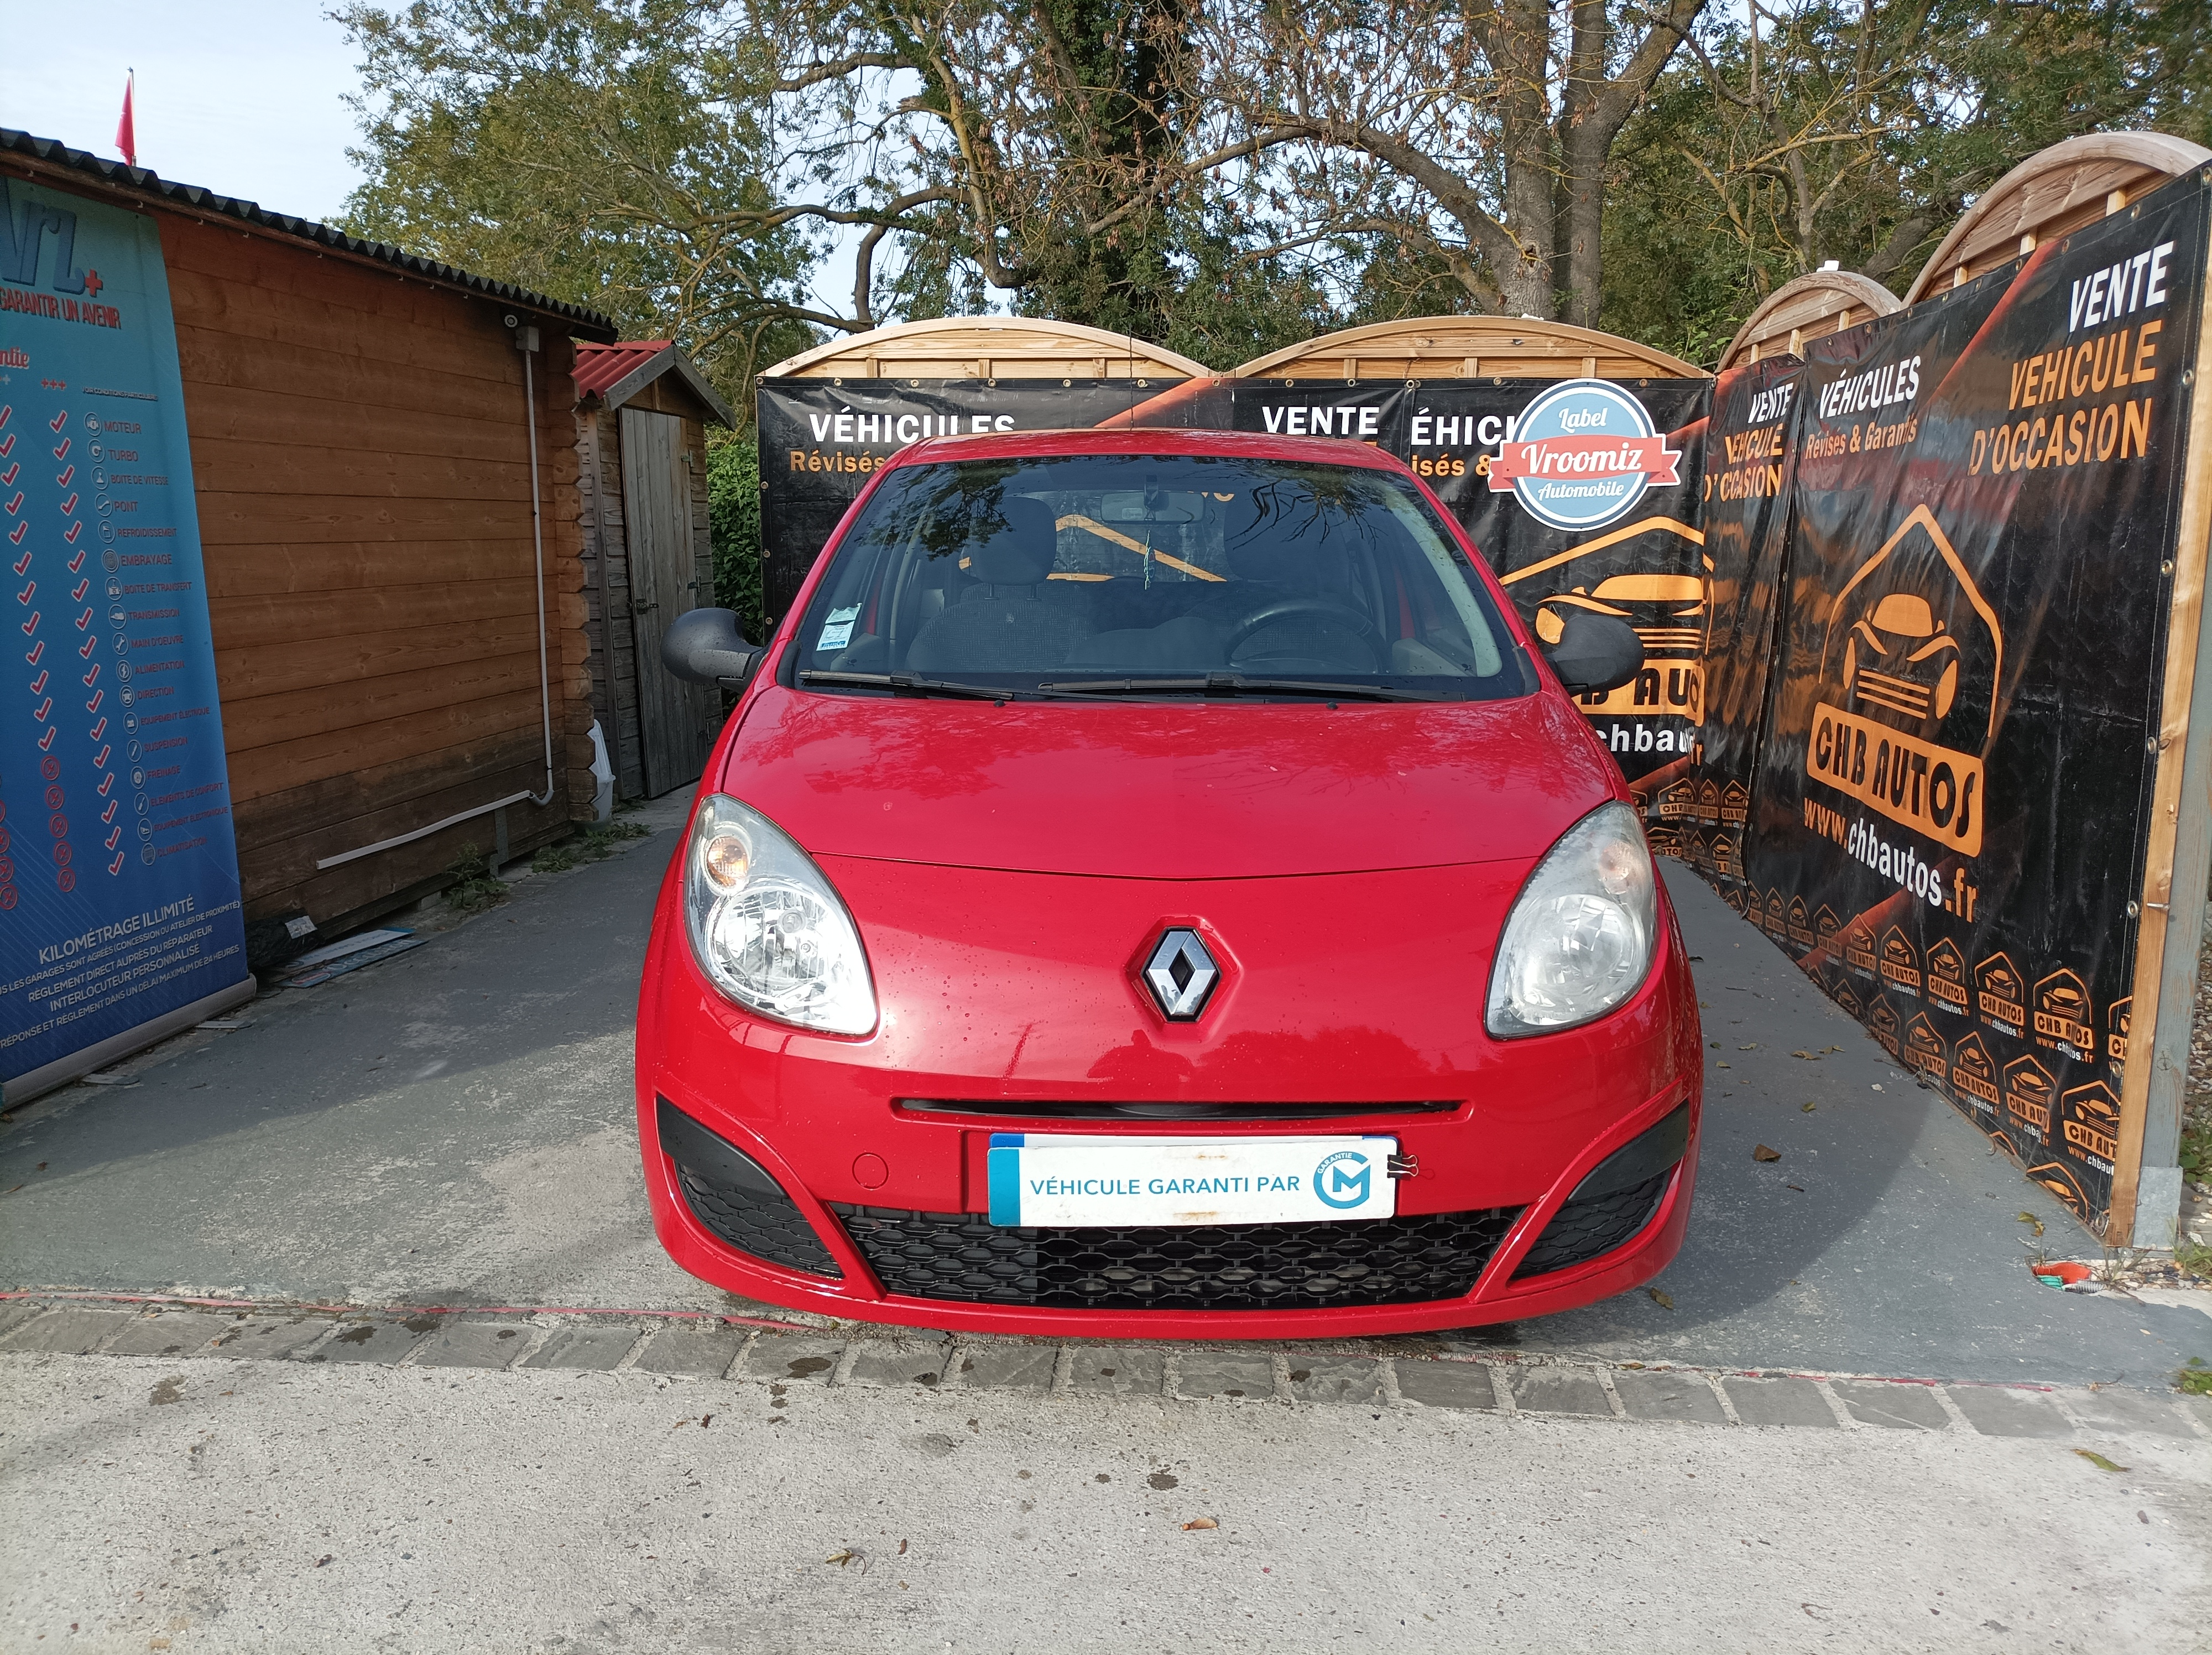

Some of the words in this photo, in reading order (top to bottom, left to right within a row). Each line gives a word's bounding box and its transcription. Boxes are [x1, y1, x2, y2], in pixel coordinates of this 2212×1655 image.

[2069, 241, 2174, 332] VENTE
[61, 298, 79, 322] UN
[82, 301, 121, 329] AVENIR
[2008, 319, 2163, 412] VEHICULE
[1819, 356, 1921, 419] VÉHICULES
[1748, 383, 1793, 424] VENTE
[104, 420, 141, 434] MOTEUR
[1262, 407, 1379, 435] VENTE
[1411, 408, 1516, 445] ÉHIC
[1558, 407, 1608, 433] Label
[1806, 426, 1846, 459] Révisés
[1850, 425, 1861, 452] &
[1969, 398, 2152, 476] D'OCCASION
[108, 450, 138, 461] TURBO
[790, 450, 885, 473] Révisés
[1521, 442, 1643, 473] Vroomiz
[111, 475, 131, 484] BOITE
[133, 476, 142, 485] DE
[144, 476, 168, 485] VITESSE
[1537, 482, 1624, 501] Automobile
[114, 501, 138, 512] PONT
[118, 528, 176, 538] REFROIDISSEMENT
[121, 554, 172, 566] EMBRAYAGE
[124, 585, 145, 594] BOITE
[146, 584, 155, 593] DE
[128, 608, 180, 621] TRANSMISSION
[131, 638, 150, 648] MAIN
[135, 660, 184, 674] ALIMENTATION
[137, 686, 174, 699] DIRECTION
[140, 712, 178, 725] EQUIPEMENT
[144, 737, 187, 752] SUSPENSION
[147, 765, 180, 779] FREINAGE
[1815, 716, 1867, 787] CHB
[1877, 738, 1976, 839] AUTOS
[186, 789, 194, 798] DE
[157, 836, 207, 857] CLIMATISATION
[1803, 797, 1978, 923] www.chbautos.fr
[39, 915, 140, 965] KILOMÉTRAGE
[143, 893, 195, 928] ILLIMITÉ
[9, 979, 24, 991] LES
[25, 965, 65, 985] GARAGES
[65, 957, 85, 971] SONT
[87, 945, 113, 963] AGRÉÉS
[114, 929, 160, 952] (CONCESSION
[160, 925, 169, 935] OU
[170, 917, 196, 931] ATELIER
[196, 913, 205, 922] DE
[206, 900, 240, 918] PROXIMITÉ)
[28, 974, 85, 1002] RÈGLEMENT
[87, 961, 114, 981] DIRECT
[117, 948, 149, 968] AUPRÈS
[150, 944, 163, 955] DU
[163, 925, 212, 951] RÉPARATEUR
[1858, 952, 1876, 970] AUTOS
[50, 970, 132, 1012] INTERLOCUTEUR
[133, 942, 200, 977] PERSONNALISÉ
[1882, 962, 1894, 976] CHB
[1896, 966, 1918, 984] AUTOS
[1, 1024, 43, 1048] RÉPONSE
[43, 1019, 54, 1031] ET
[56, 1000, 104, 1026] RÈGLEMENT
[105, 991, 125, 1006] DANS
[126, 986, 138, 997] UN
[138, 977, 159, 991] DÉLAI
[159, 964, 194, 983] MAXIMUM
[195, 959, 203, 968] DE
[204, 956, 213, 965] 24
[213, 944, 239, 961] HEURES
[1930, 977, 1942, 993] CHB
[1943, 983, 1964, 1002] AUTOS
[1982, 995, 1996, 1012] CHB
[1998, 998, 2021, 1022] AUTOS
[1980, 1014, 2024, 1039] www.chbautos.fr
[2038, 1015, 2061, 1033] CHB
[1955, 1070, 1969, 1087] CHB
[1971, 1078, 1997, 1101] AUTOS
[2009, 1096, 2026, 1118] CHB
[2069, 1125, 2093, 1149] CHB
[1317, 1152, 1353, 1174] GARANTIE
[1031, 1176, 1140, 1195] VÉHICULE
[1149, 1177, 1249, 1195] GARANTI
[1257, 1176, 1300, 1193] PAR
